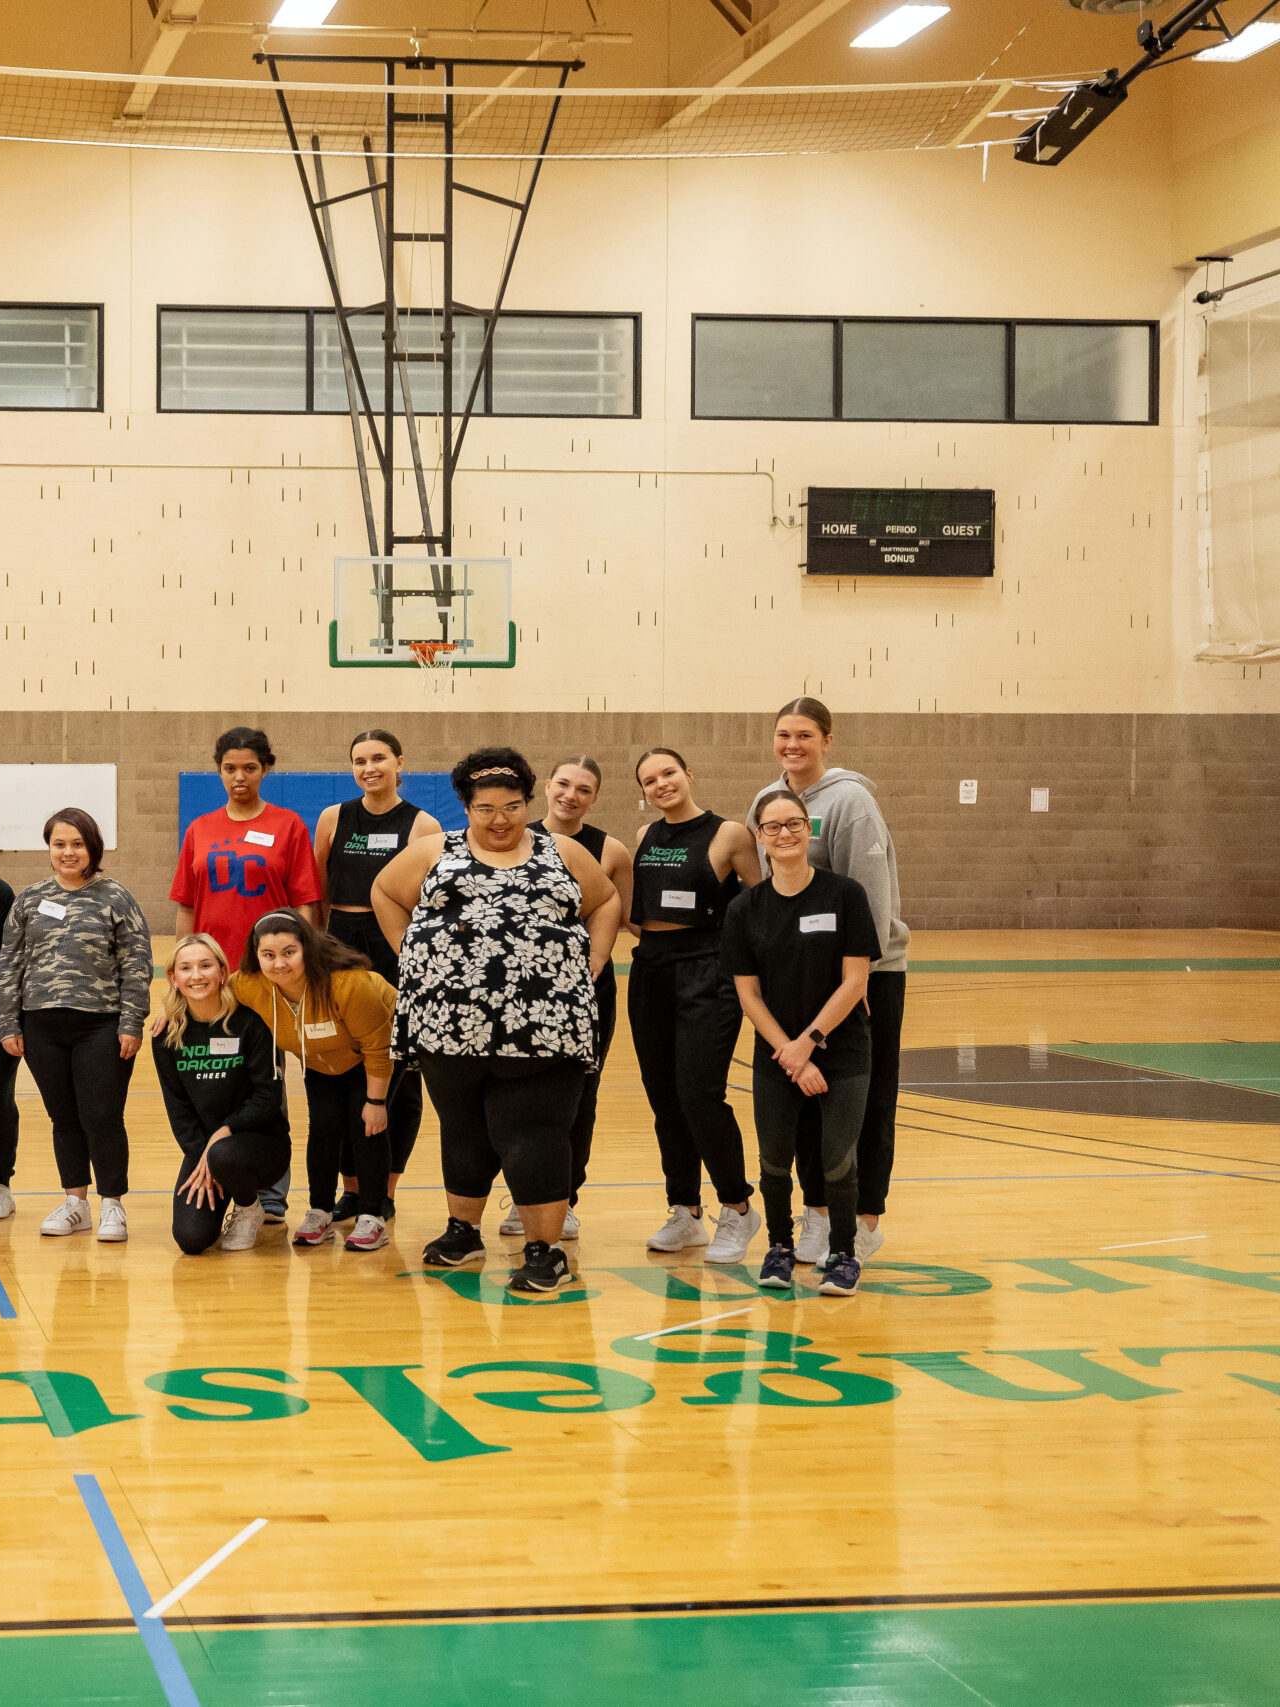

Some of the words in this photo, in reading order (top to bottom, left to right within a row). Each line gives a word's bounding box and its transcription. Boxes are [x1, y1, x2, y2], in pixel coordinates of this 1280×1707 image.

[821, 524, 857, 535] HOME
[885, 525, 917, 534] PERIOD
[942, 525, 981, 536] GUEST
[884, 554, 915, 563] BONUS
[207, 850, 266, 898] DC
[176, 1056, 244, 1072] DAKOTA
[196, 1071, 227, 1080] CHEER
